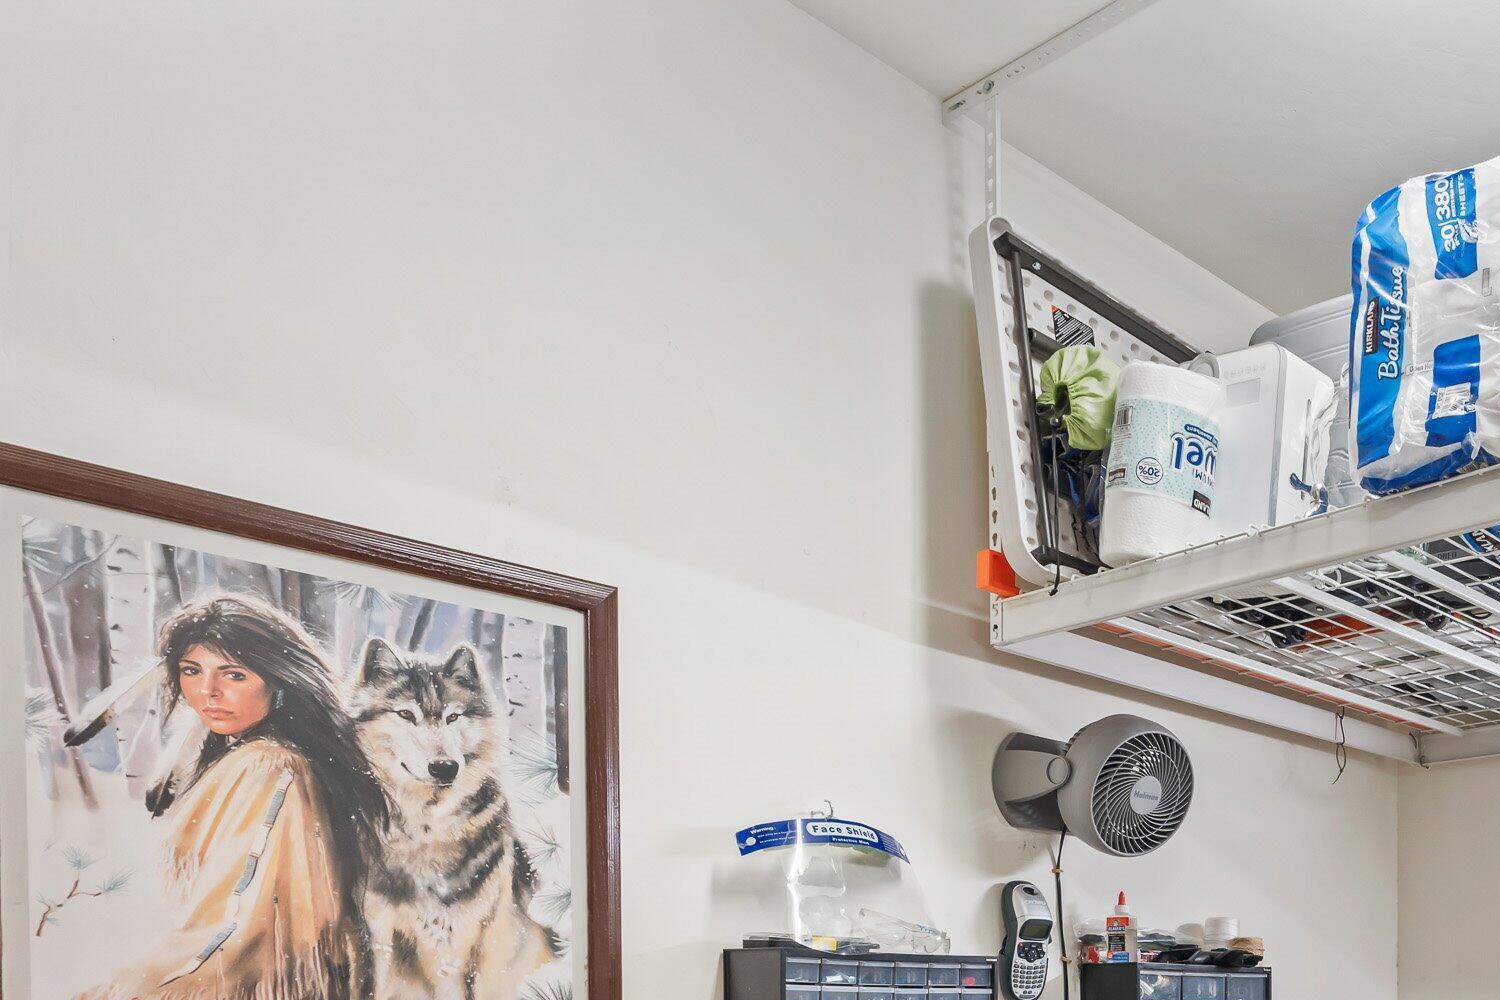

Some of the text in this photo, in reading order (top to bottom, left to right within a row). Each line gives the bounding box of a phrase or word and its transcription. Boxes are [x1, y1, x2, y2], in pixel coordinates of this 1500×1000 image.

[1434, 178, 1456, 253] 30 380
[1365, 301, 1376, 353] KIRKLAND
[1378, 266, 1406, 380] Bath Tissue
[1138, 465, 1161, 478] 20%
[1133, 789, 1159, 801] Holmes
[812, 825, 875, 840] Face Shield
